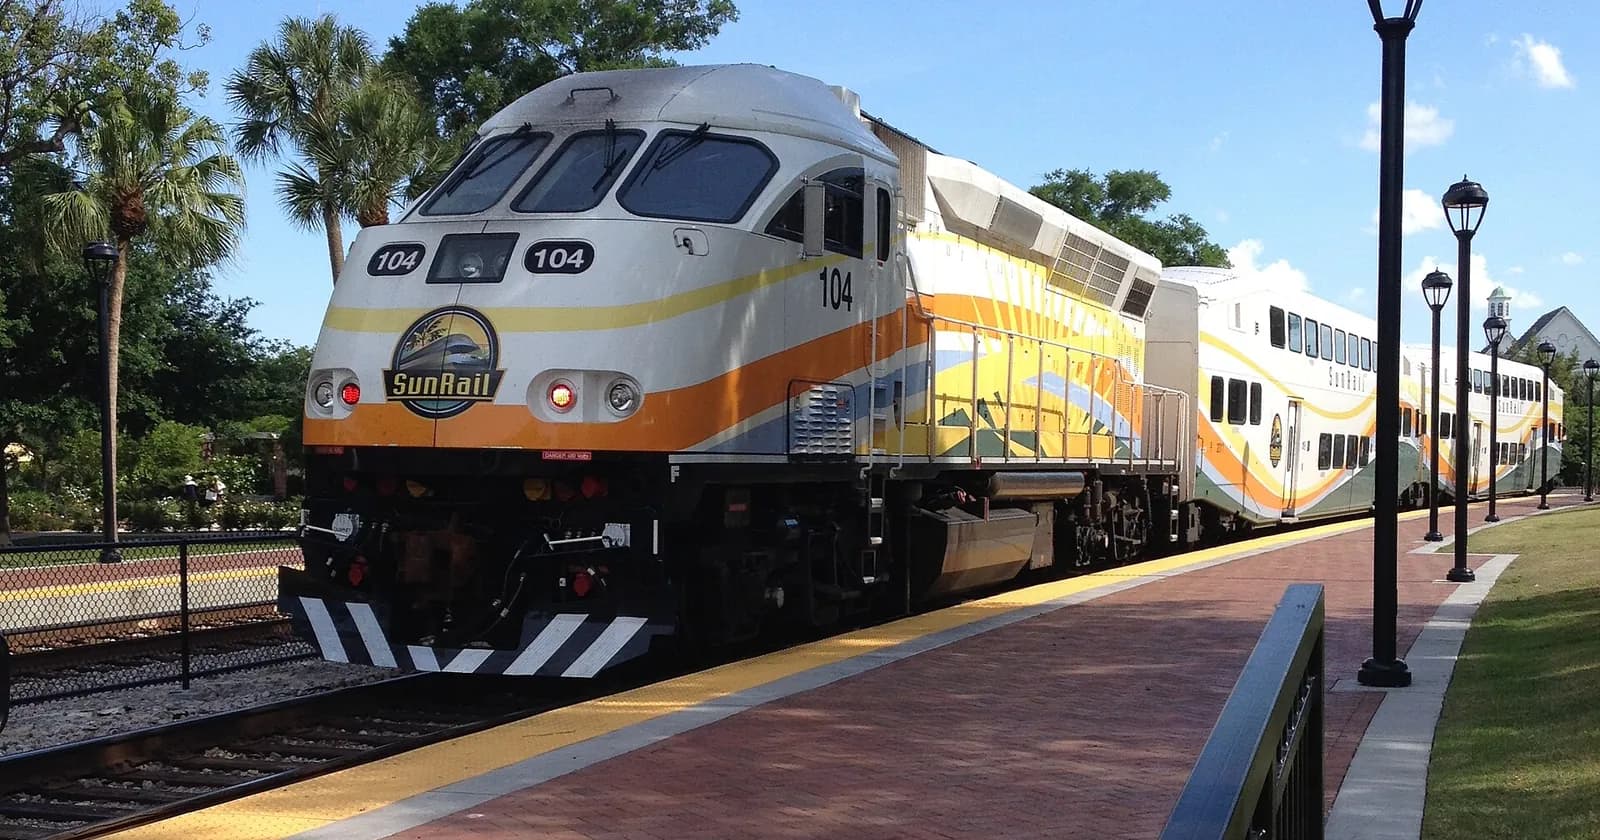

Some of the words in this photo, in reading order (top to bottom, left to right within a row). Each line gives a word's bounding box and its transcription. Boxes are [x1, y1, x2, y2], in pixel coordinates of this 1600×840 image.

[376, 250, 419, 271] 104
[534, 248, 584, 269] 104
[819, 266, 853, 312] 104
[392, 372, 490, 396] SunRail
[670, 465, 680, 483] F
